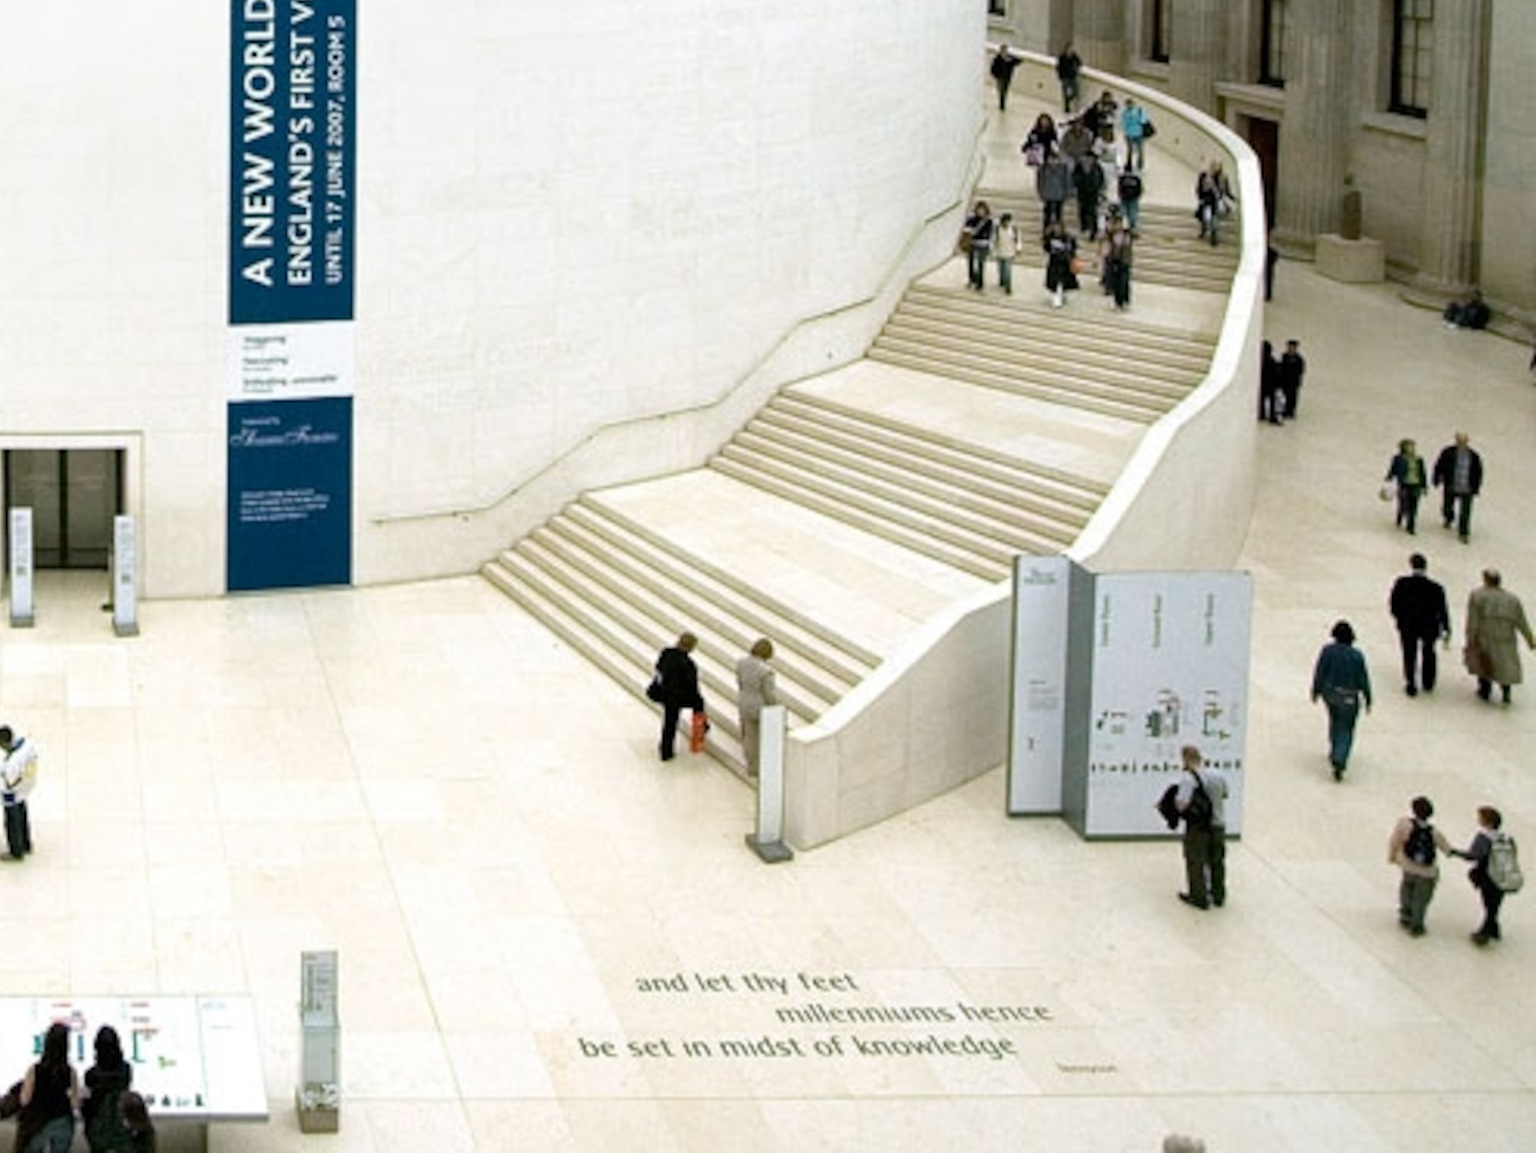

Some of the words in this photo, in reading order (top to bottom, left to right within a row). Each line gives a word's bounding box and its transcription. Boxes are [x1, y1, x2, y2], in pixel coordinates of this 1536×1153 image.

[290, 31, 315, 109] FIRST
[327, 32, 345, 92] ROOM
[326, 96, 345, 147] 2007,
[326, 149, 345, 198] JUNE
[242, 153, 274, 247] NEW
[287, 117, 315, 285] ENGLAND'S
[325, 201, 343, 223] 17
[242, 258, 274, 287] A
[325, 227, 343, 285] UNTIL
[636, 973, 689, 992] and
[694, 973, 738, 992] let
[741, 973, 789, 995] thy
[797, 972, 860, 992] feet
[775, 1003, 956, 1024] millenniums
[959, 1001, 1054, 1022] hence
[578, 1037, 618, 1058] be
[626, 1037, 676, 1058] set
[682, 1037, 713, 1058] in
[719, 1035, 806, 1058] midst
[813, 1034, 846, 1057] of
[852, 1034, 1019, 1061] knowledge
